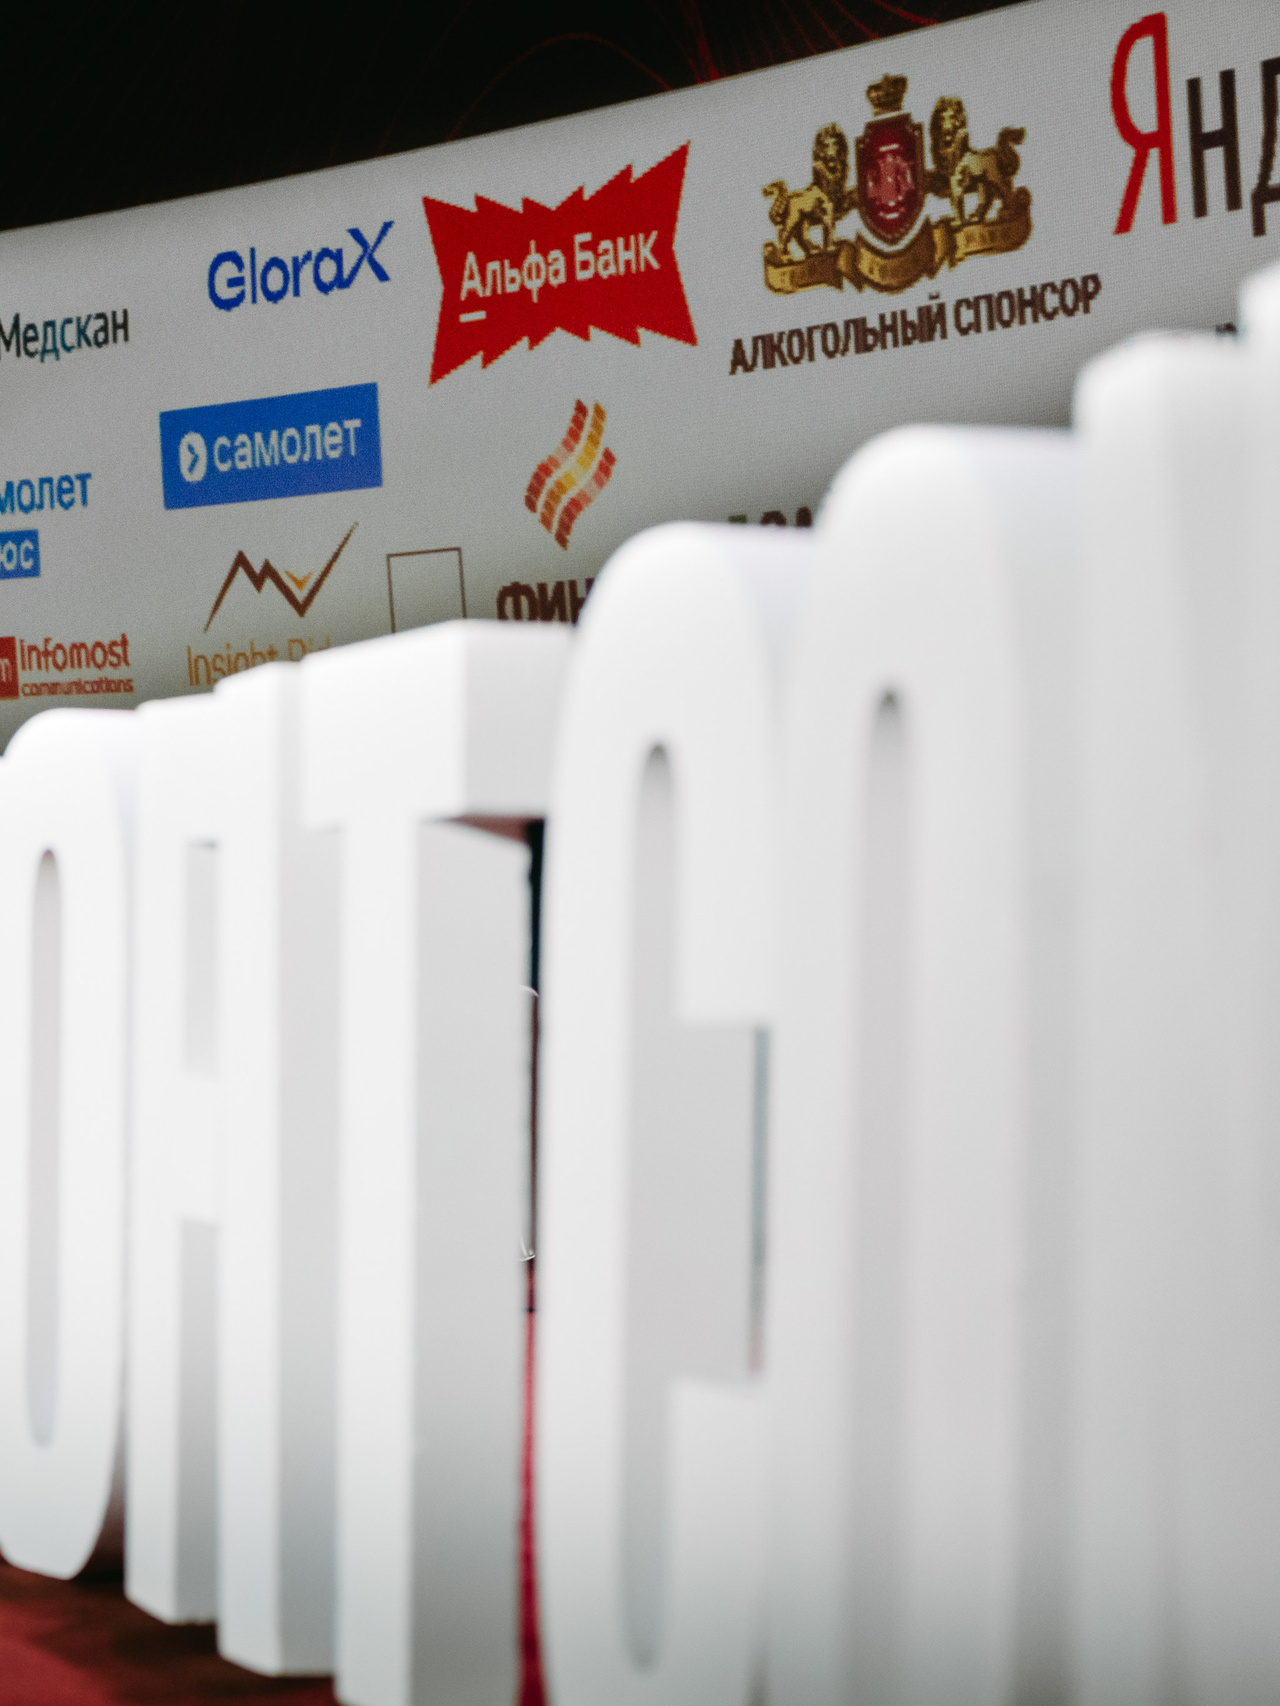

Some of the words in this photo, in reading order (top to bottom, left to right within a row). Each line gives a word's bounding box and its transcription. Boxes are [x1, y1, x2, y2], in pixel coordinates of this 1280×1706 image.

[208, 220, 395, 311] GloraX
[460, 239, 566, 304] Альфа
[574, 229, 661, 282] Банк
[729, 291, 948, 375] АЛКОГОЛЬНЫЙ
[953, 272, 1103, 338] СПОНСОР
[214, 417, 362, 471] самолет
